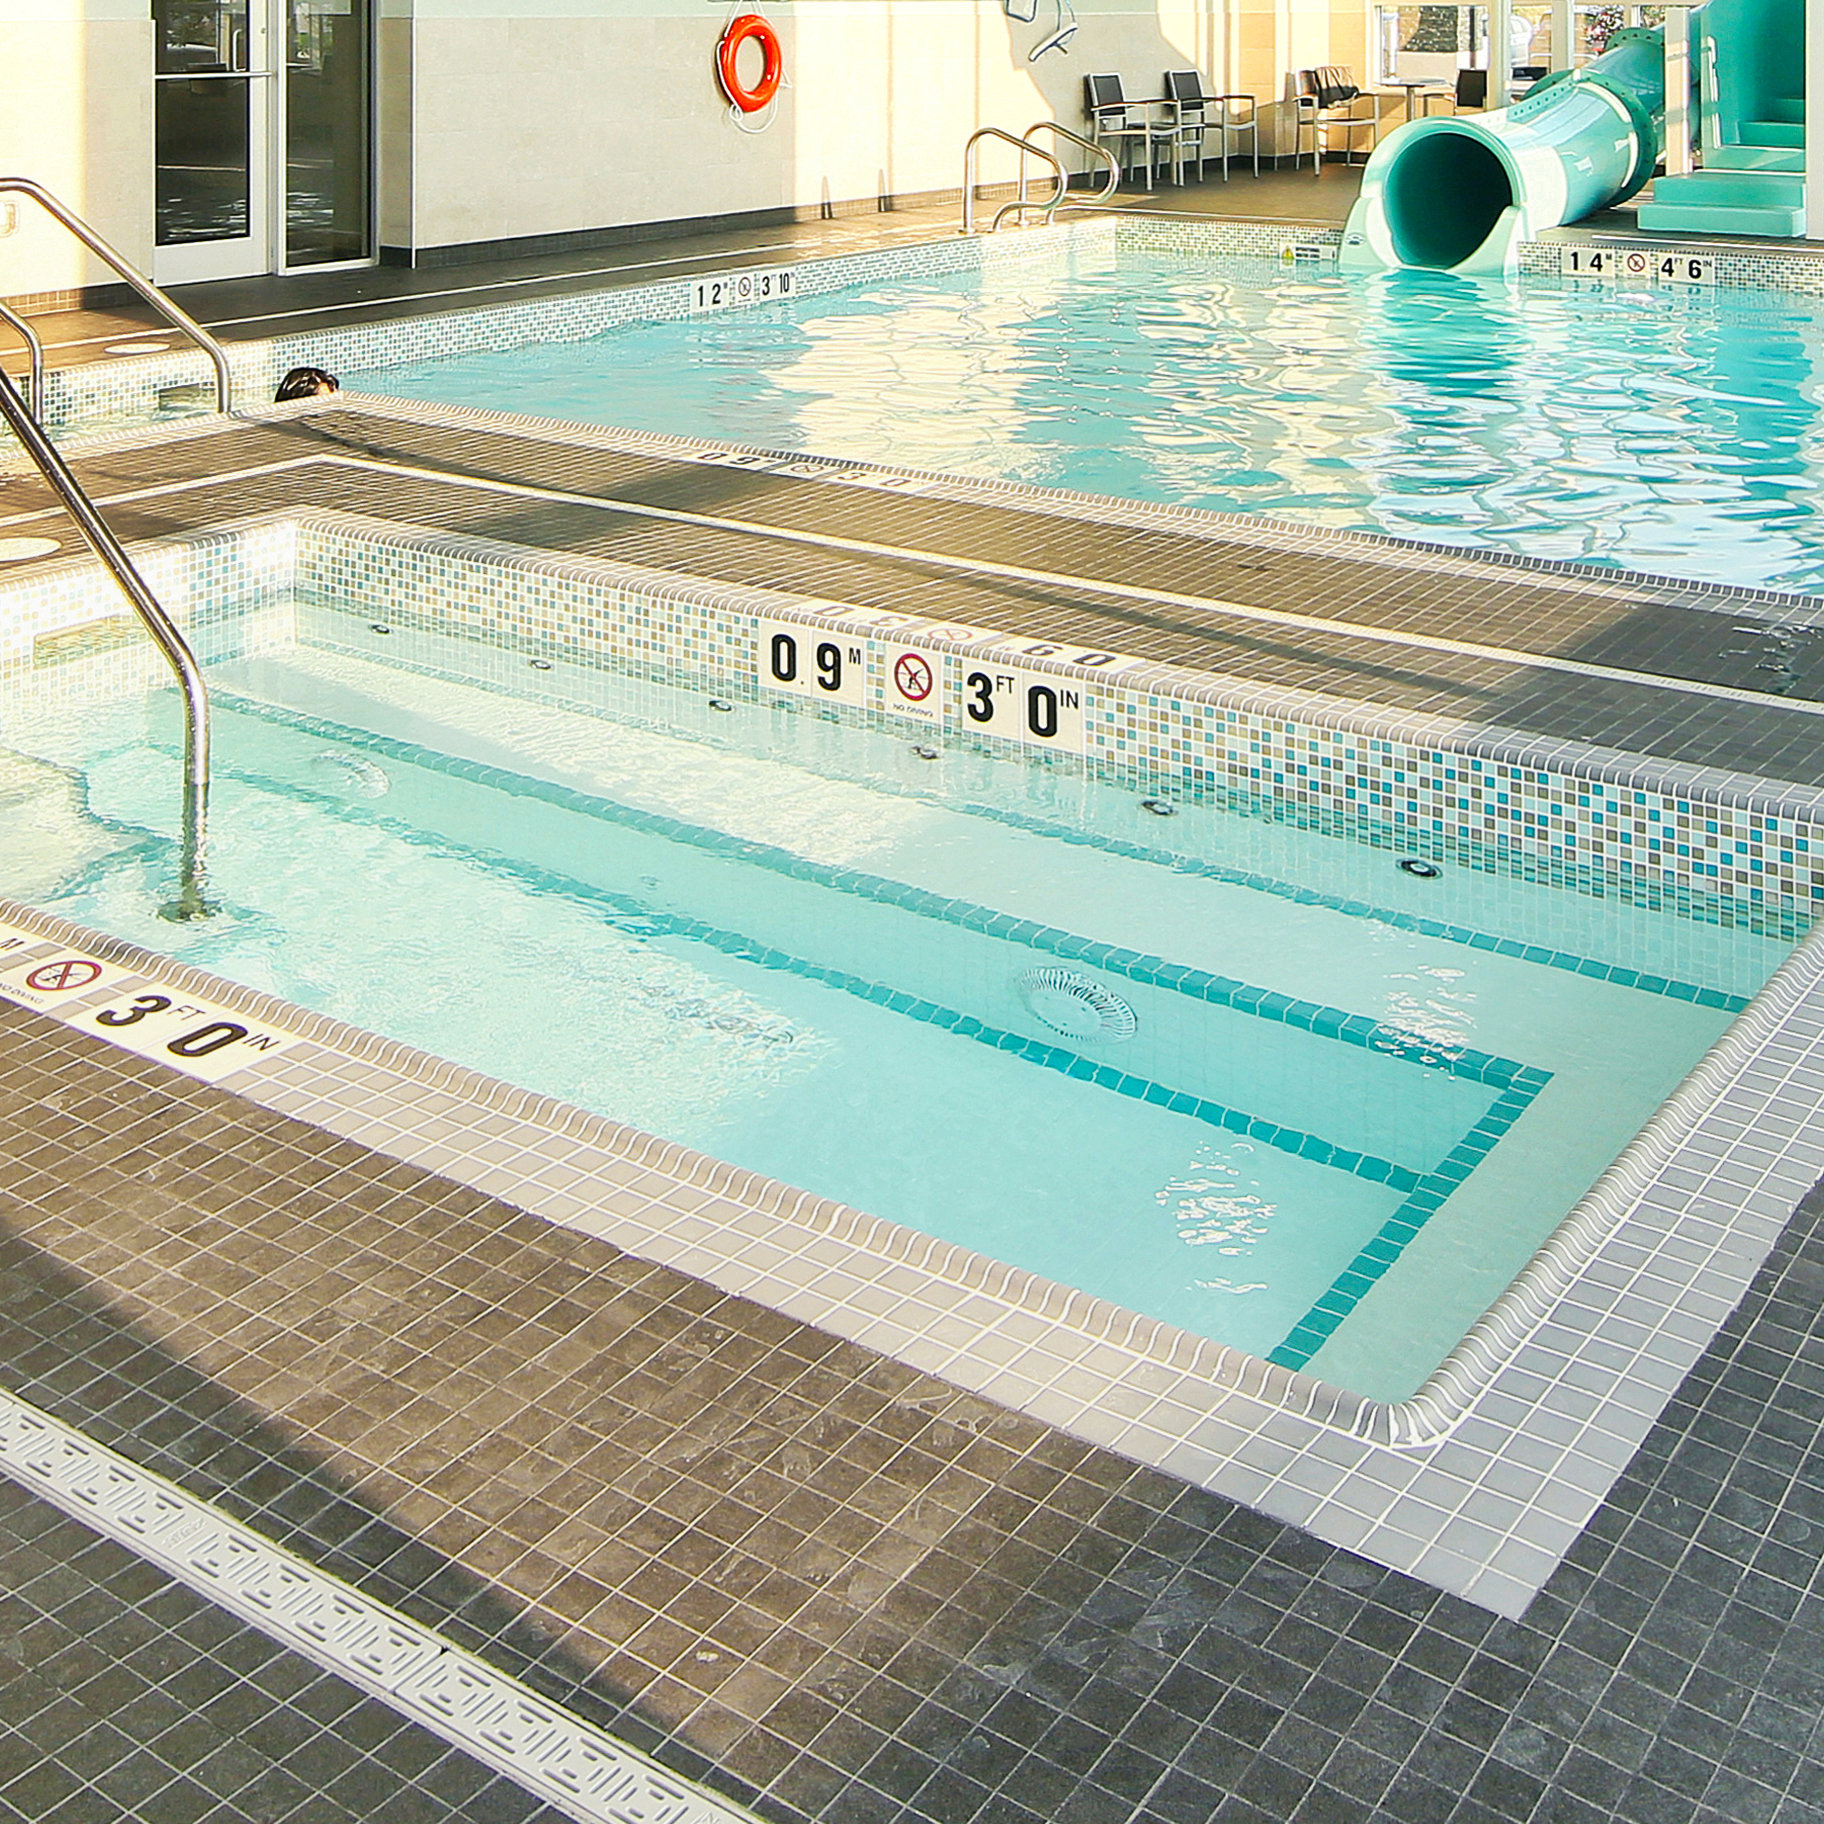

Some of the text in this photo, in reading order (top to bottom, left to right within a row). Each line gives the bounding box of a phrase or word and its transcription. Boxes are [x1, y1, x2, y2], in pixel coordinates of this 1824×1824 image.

[1688, 259, 1702, 279] 6
[779, 272, 790, 294] 10
[848, 647, 862, 665] M
[966, 671, 994, 723] 3
[996, 675, 1016, 694] FT
[1028, 685, 1058, 738] 0
[1060, 689, 1079, 710] IN
[893, 703, 933, 718] NO DIVING
[0, 937, 21, 952] M
[11, 988, 45, 1005] DIVING
[95, 994, 173, 1028] 3
[166, 1004, 206, 1021] FT
[166, 1021, 249, 1058] 0
[243, 1033, 280, 1052] IN
